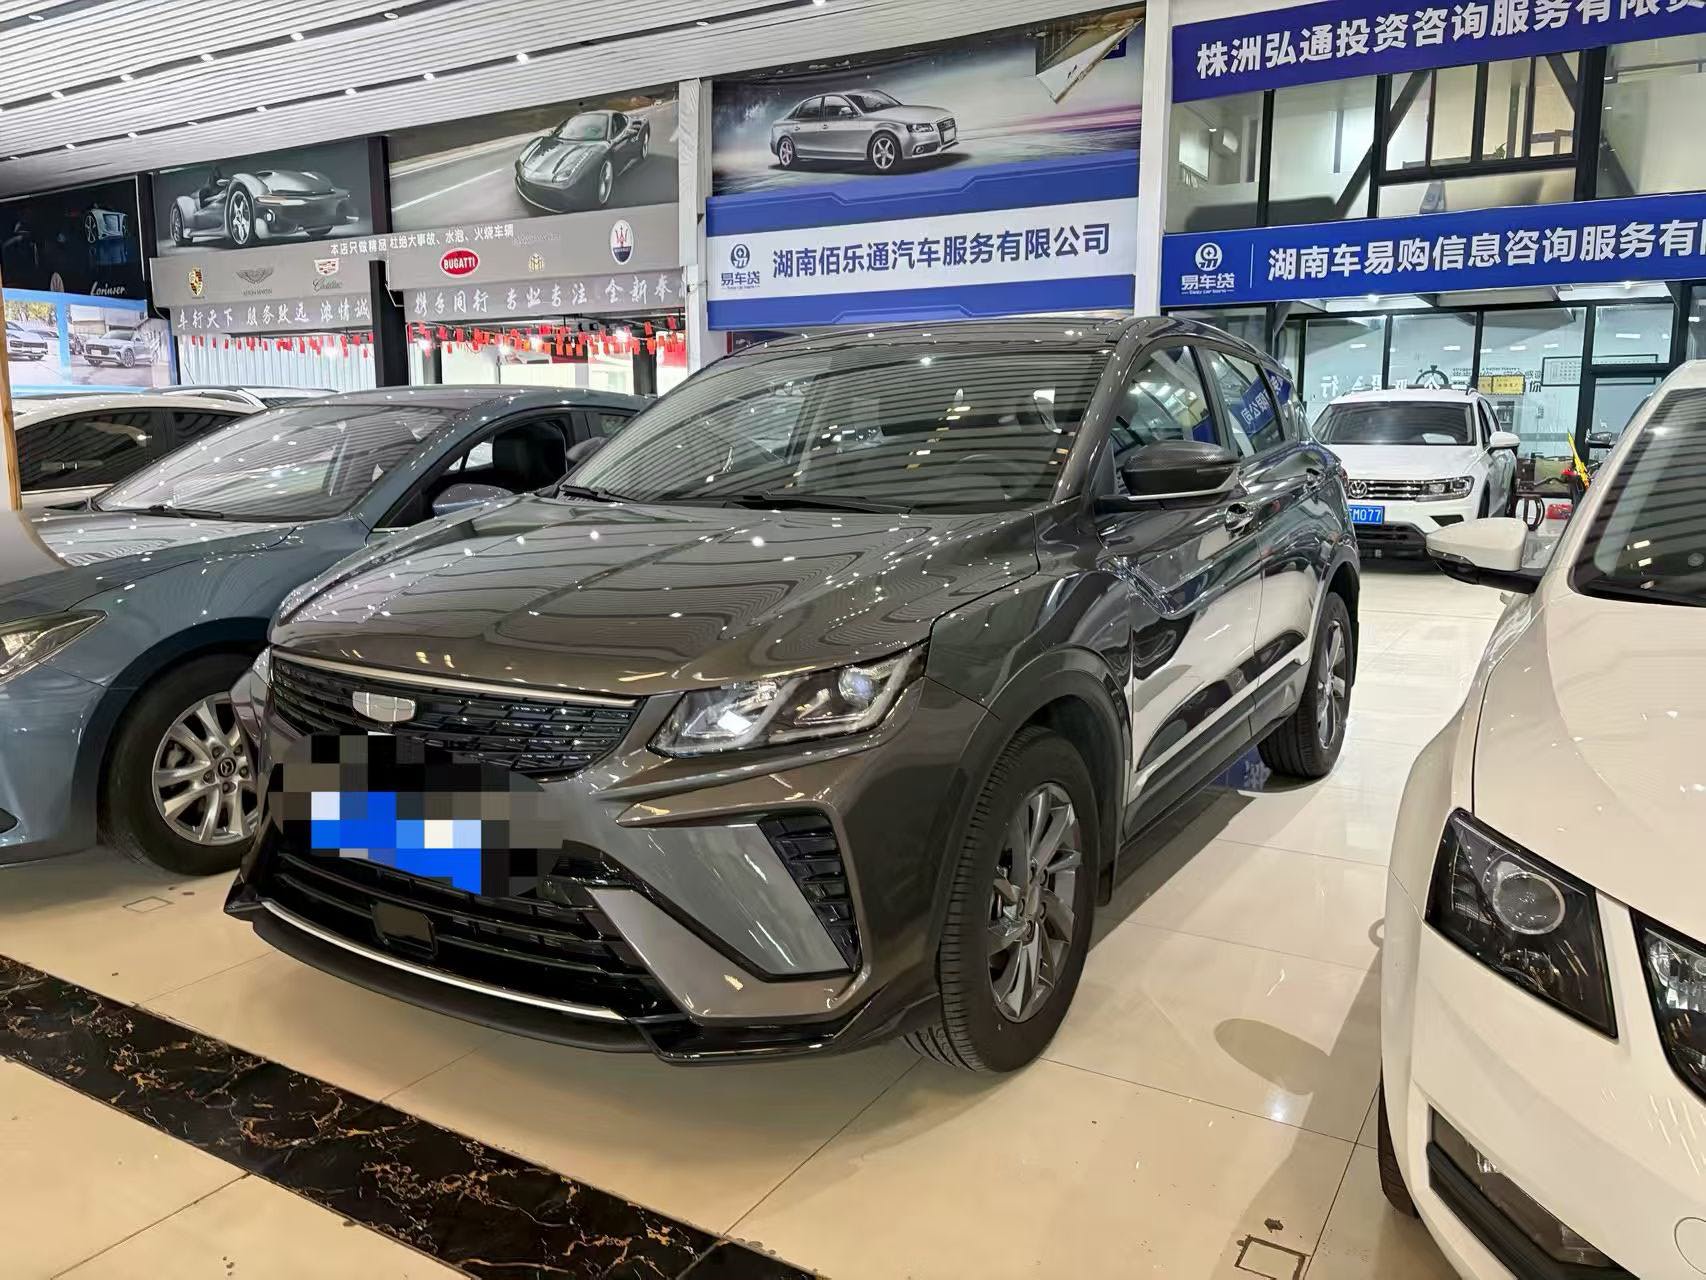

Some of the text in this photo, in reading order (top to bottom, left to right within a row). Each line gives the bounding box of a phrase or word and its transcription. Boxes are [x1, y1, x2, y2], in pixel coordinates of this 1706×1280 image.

[330, 236, 387, 256] 本店只做精品
[772, 222, 1111, 279] 湖南佰乐通汽车服务有限公司
[1267, 218, 1706, 282] 湖南车易购信息咨询服务有
[443, 256, 476, 270] BUGATTI
[720, 270, 761, 286] 易车贷
[1180, 272, 1236, 291] 易车贷
[90, 281, 126, 297] Lorinser
[177, 306, 233, 330] 车行天下
